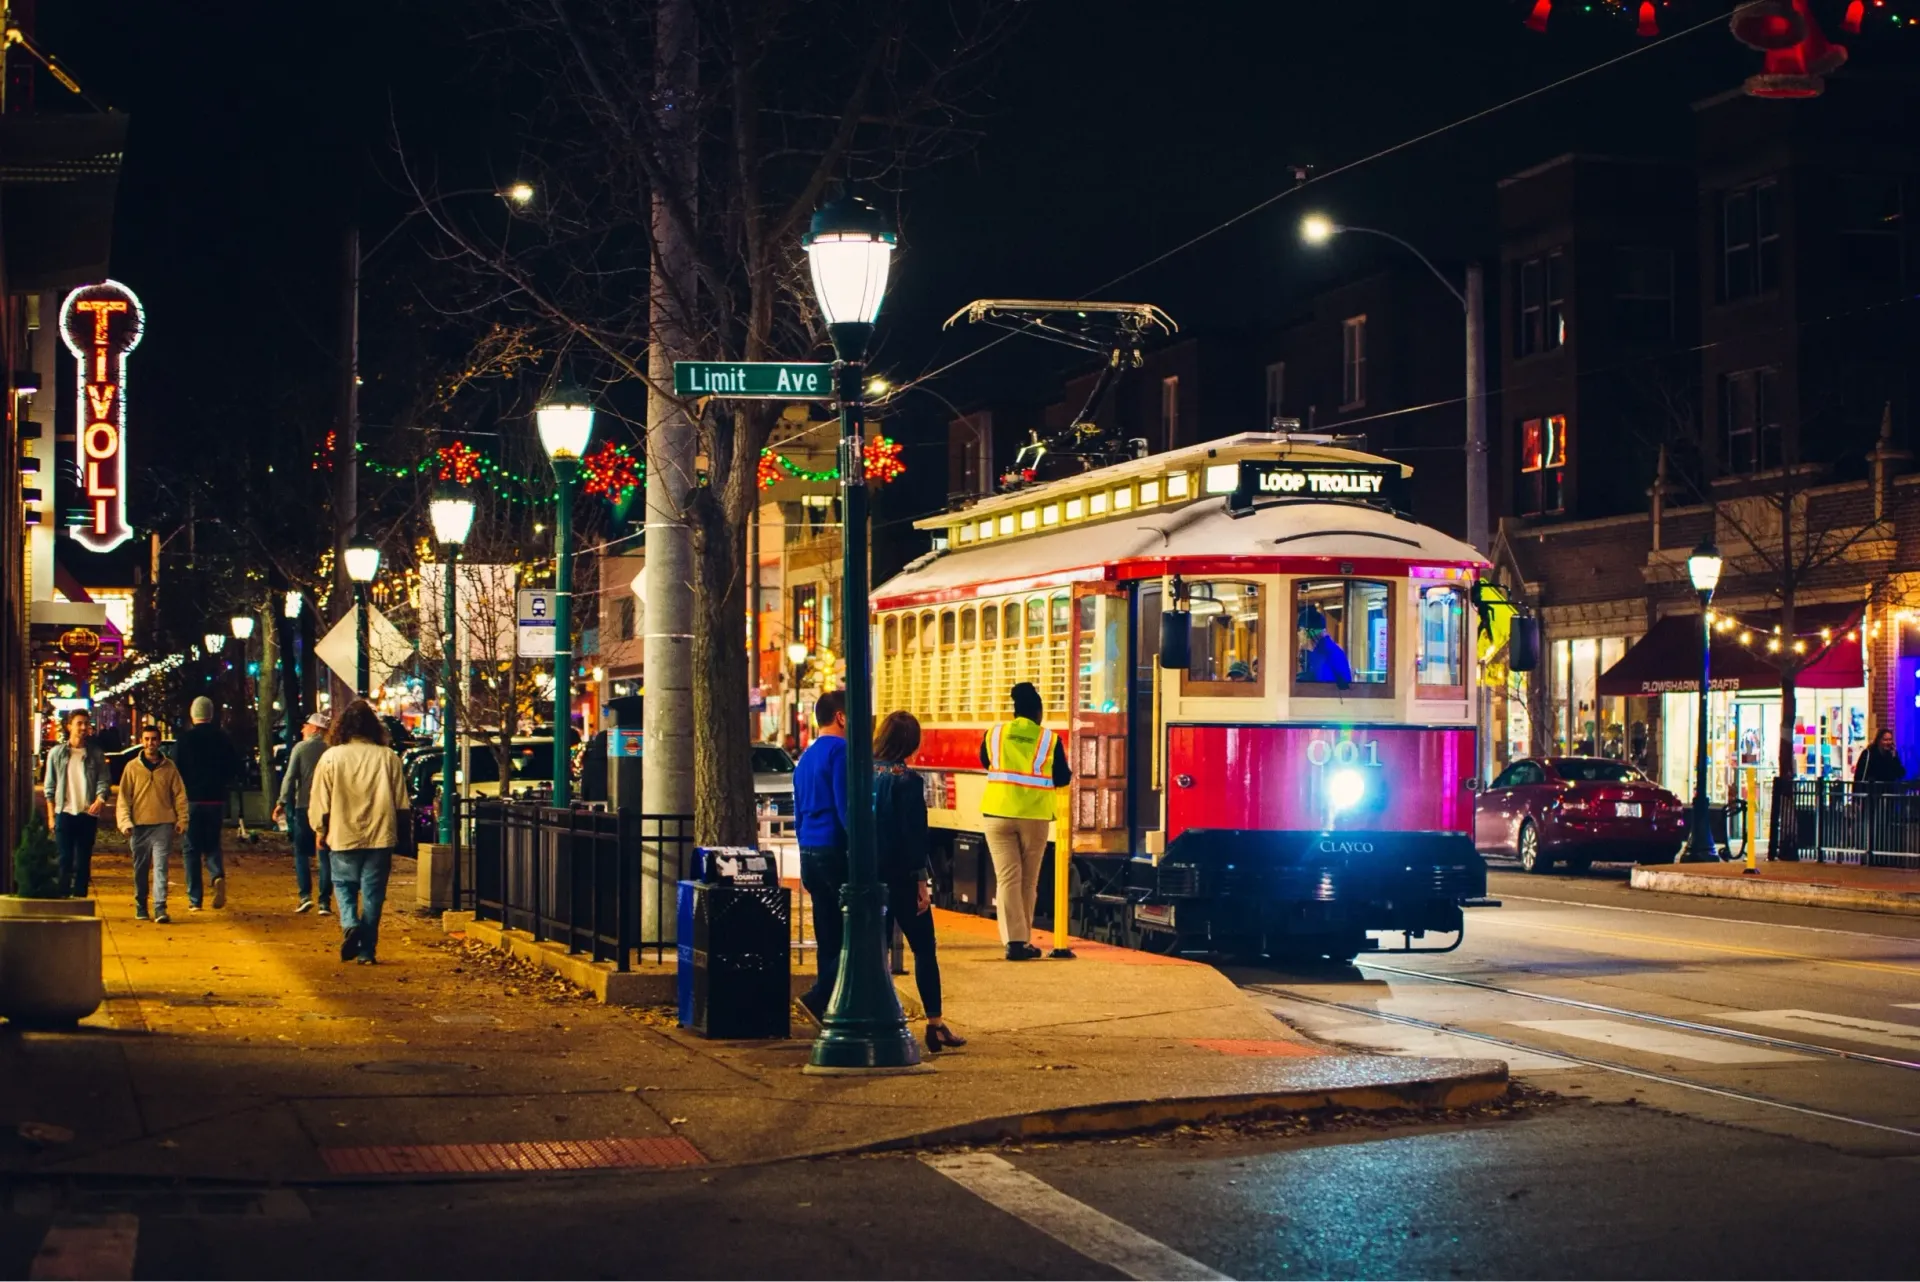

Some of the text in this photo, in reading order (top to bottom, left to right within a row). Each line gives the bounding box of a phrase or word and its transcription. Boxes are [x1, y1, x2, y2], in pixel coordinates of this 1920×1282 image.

[690, 367, 818, 391] Limit Ave
[77, 301, 127, 534] TIVOLI
[1260, 473, 1383, 492] LOOP TROLLEY
[1642, 680, 1700, 692] PLOWSHARIN
[1307, 740, 1382, 767] 001
[1320, 840, 1373, 854] CLAYCO
